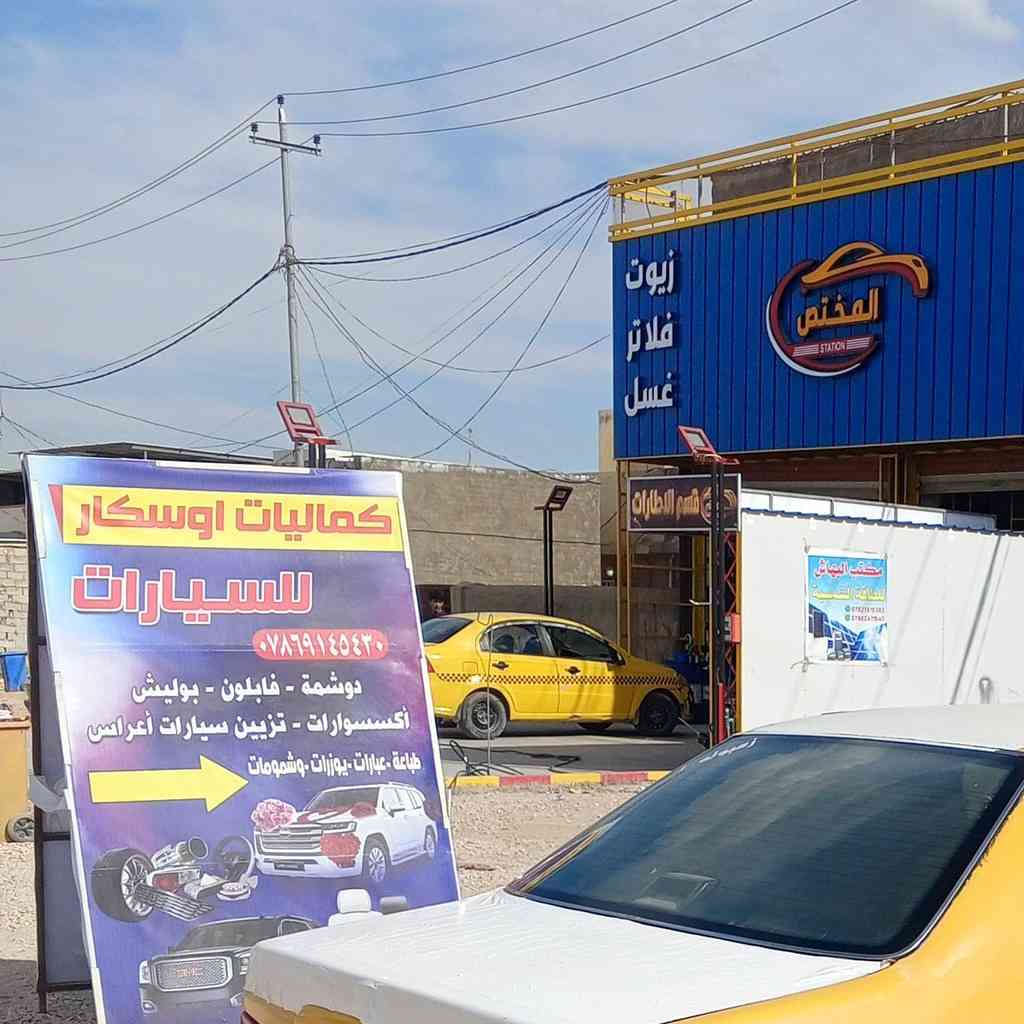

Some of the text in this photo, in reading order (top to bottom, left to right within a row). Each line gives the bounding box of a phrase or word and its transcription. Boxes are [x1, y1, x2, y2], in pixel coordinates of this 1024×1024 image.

[625, 249, 675, 295] زيوت
[797, 287, 879, 337] المختص
[626, 313, 674, 361] فلاتر
[819, 340, 847, 353] STATION
[624, 372, 674, 416] غسل
[75, 494, 392, 541] كماليات اوسكار
[72, 564, 314, 625] للسيارات
[132, 671, 363, 704] دوشمة فابلون بوليش
[88, 705, 410, 742] أكسسوارات تزيين سيارات أعراس
